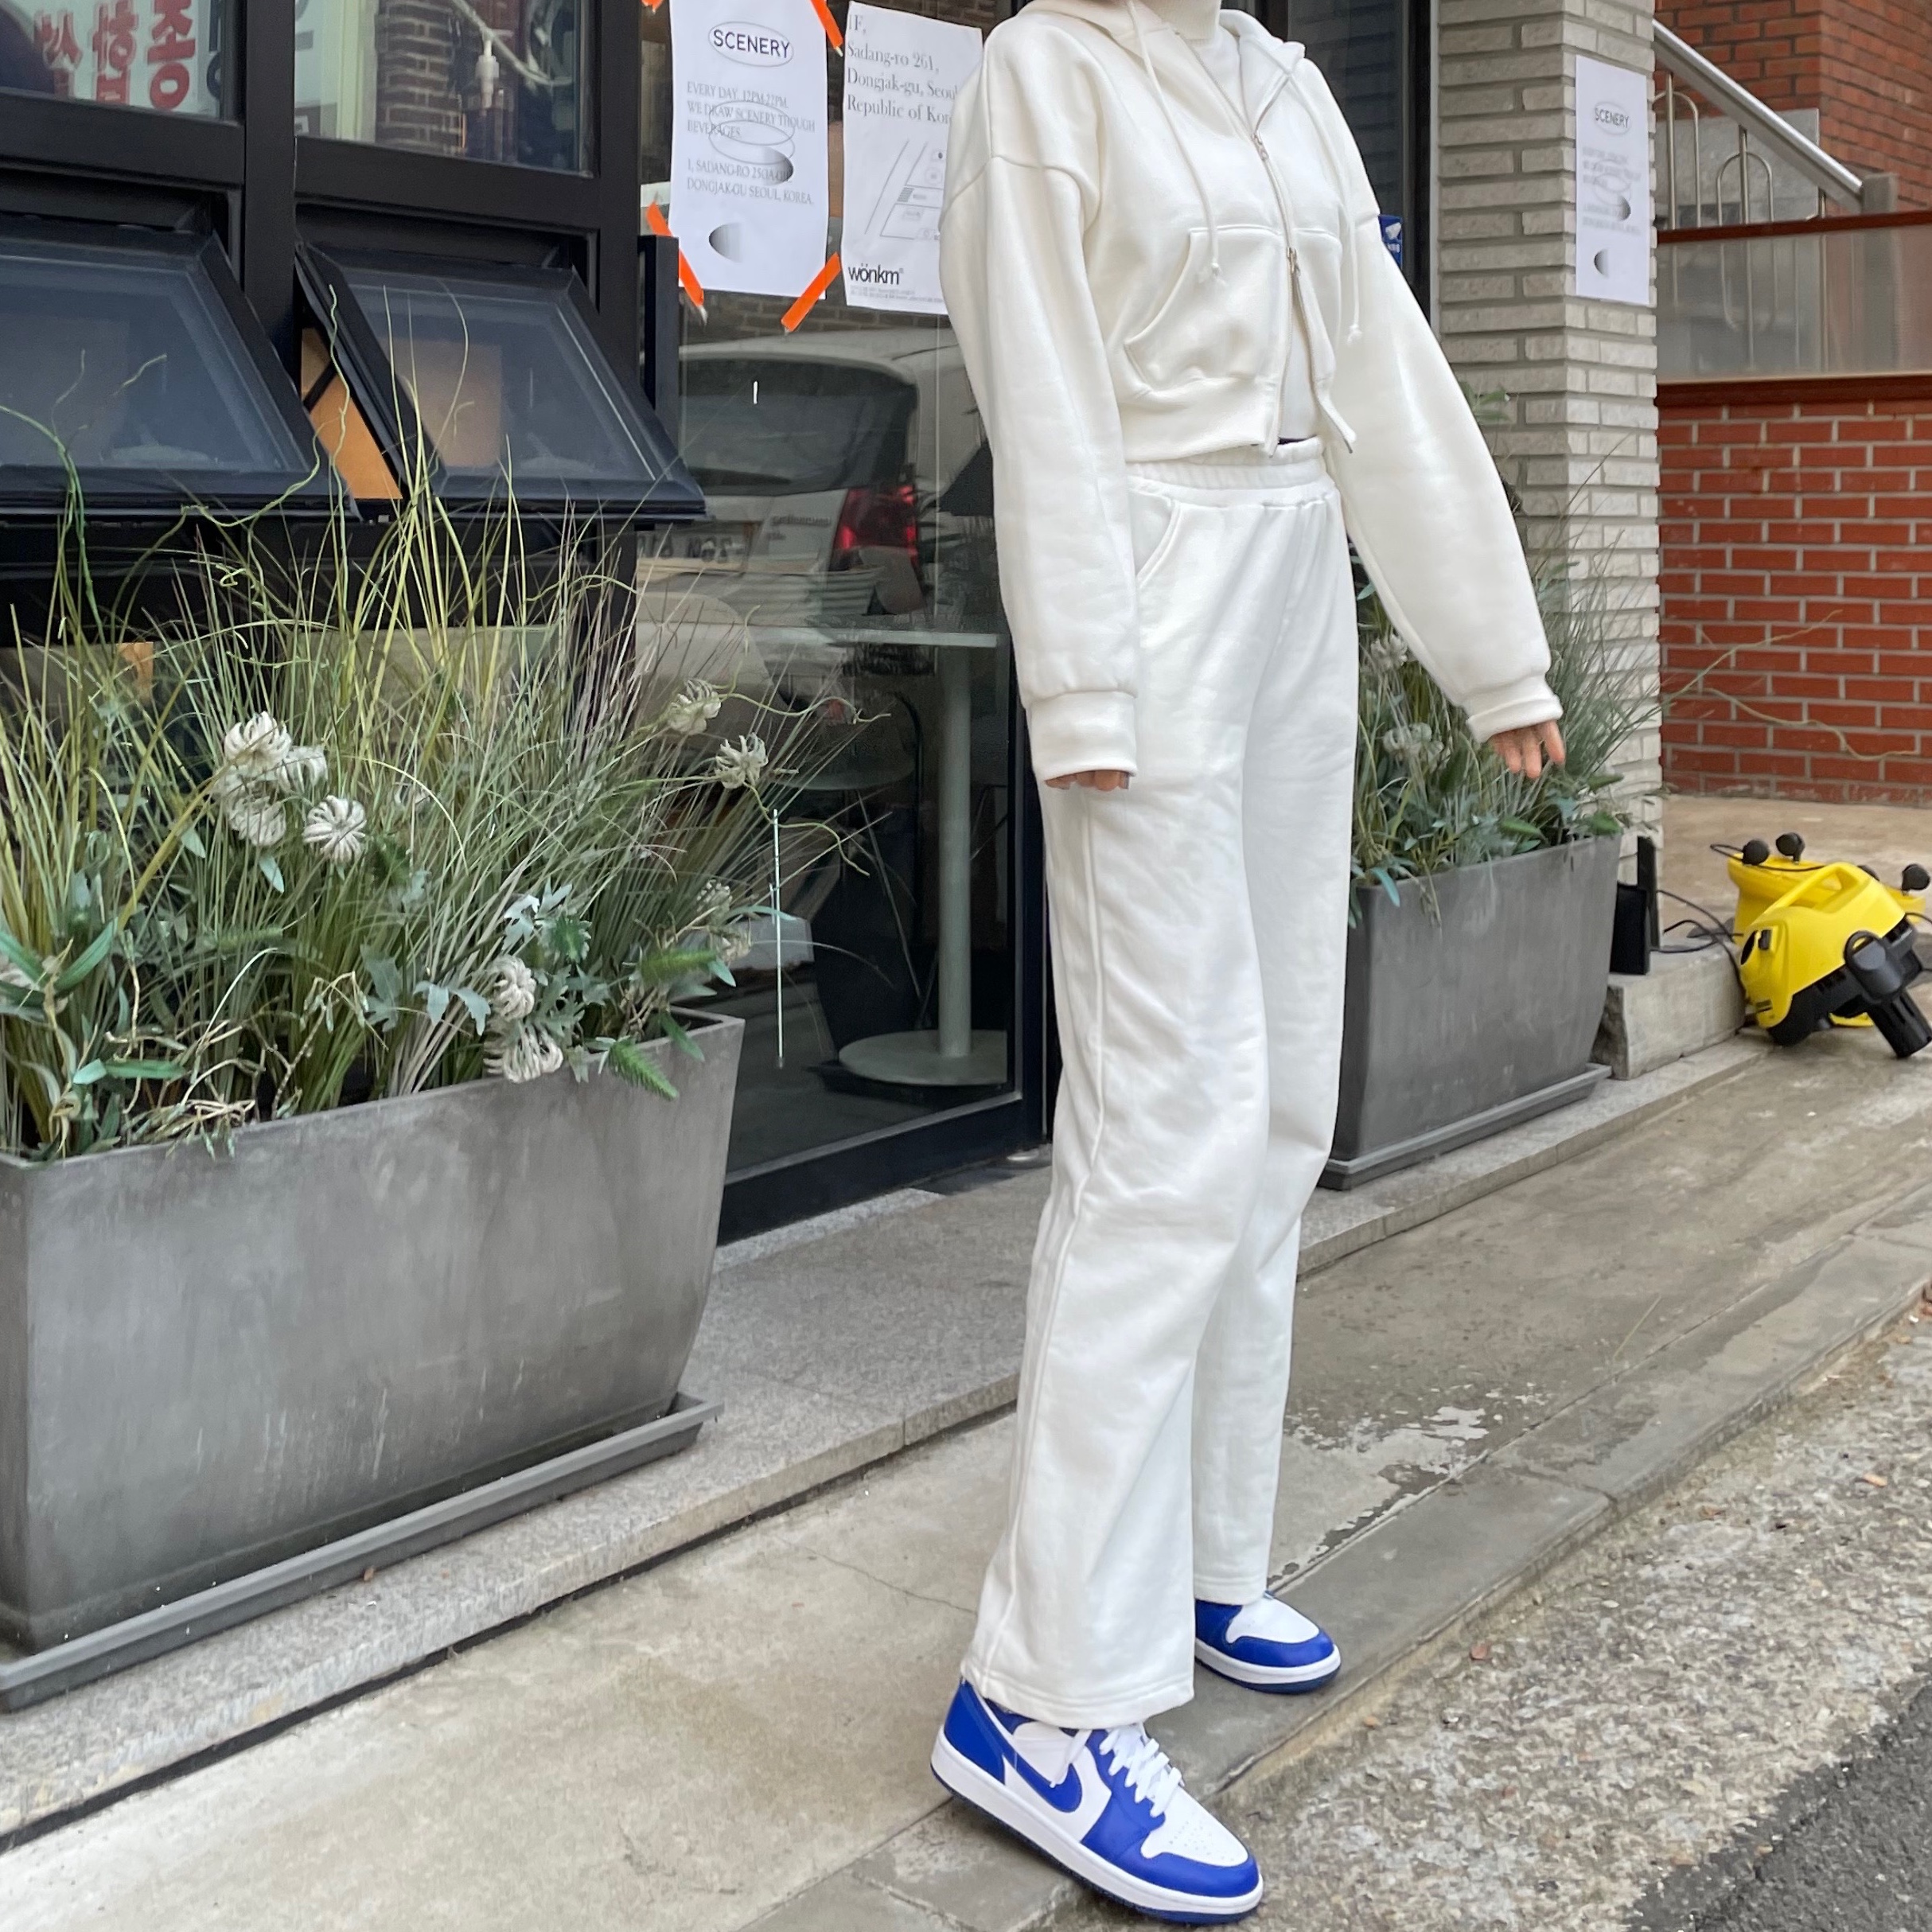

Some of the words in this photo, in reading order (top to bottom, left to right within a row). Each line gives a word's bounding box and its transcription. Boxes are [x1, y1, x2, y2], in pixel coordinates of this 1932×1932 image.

[713, 29, 790, 59] SCENERY
[847, 41, 909, 67] Sadang-ro
[687, 81, 715, 98] EVERY
[847, 67, 923, 95] Dongjak-gu,
[687, 100, 702, 115] WE
[704, 103, 732, 119] DRAW
[736, 107, 777, 125] SCENERY
[847, 94, 903, 117] Republic
[908, 104, 923, 120] of
[1595, 107, 1630, 128] SCENERY
[696, 161, 750, 178] SADANG-RO
[687, 177, 747, 197] DONGJAK-GU
